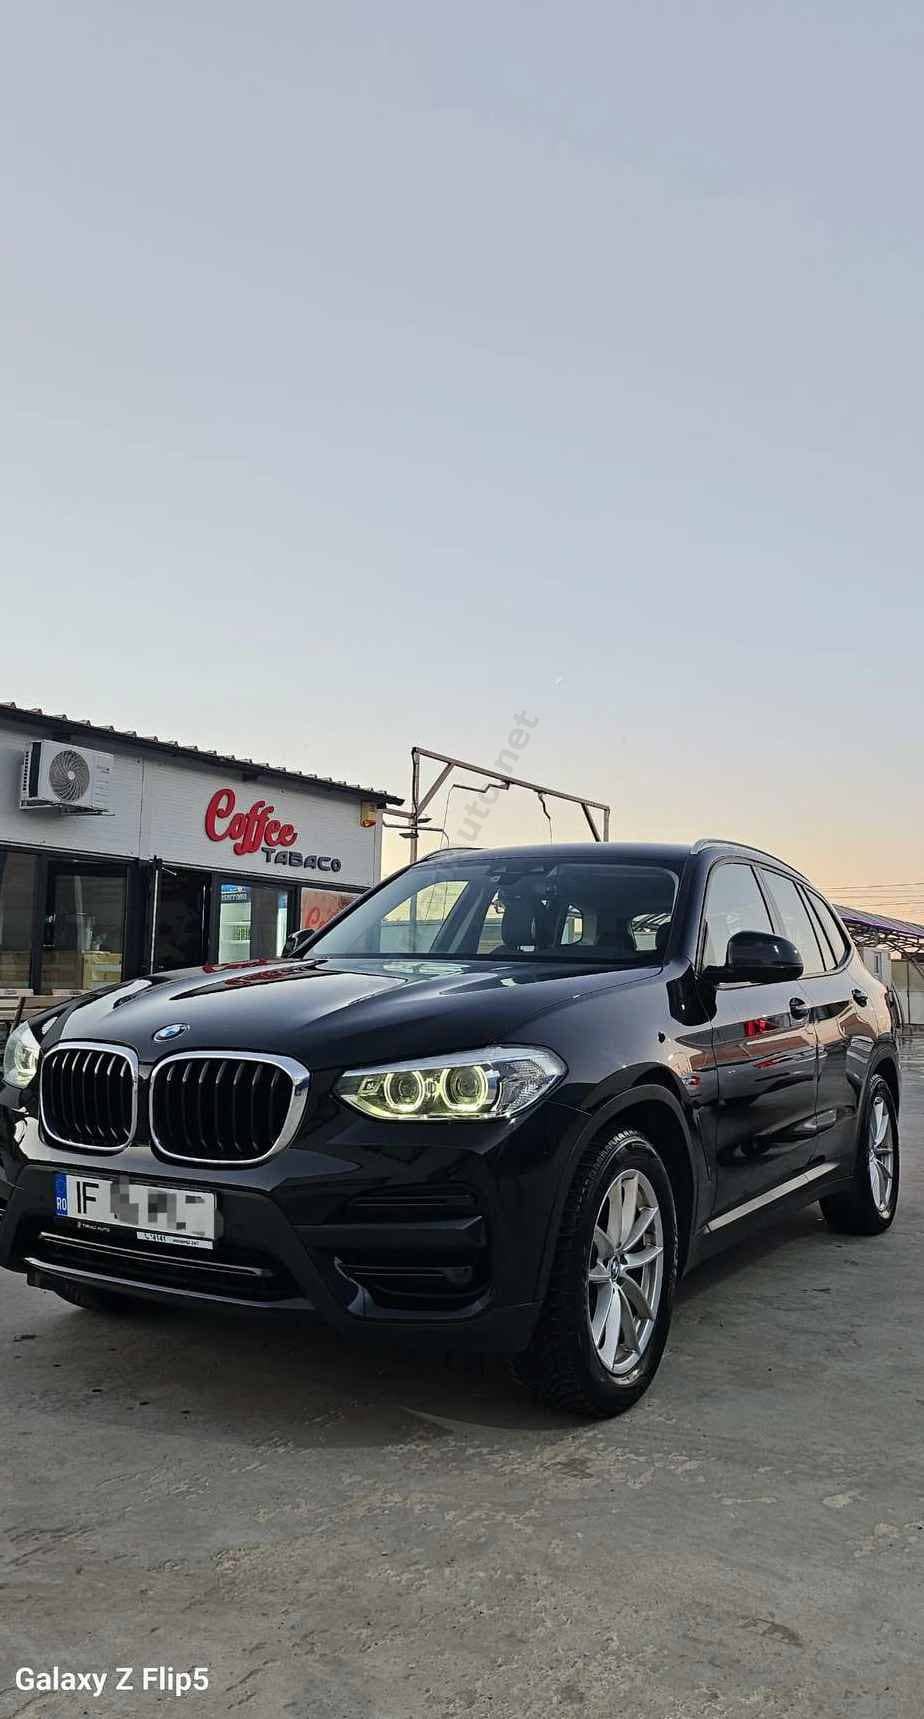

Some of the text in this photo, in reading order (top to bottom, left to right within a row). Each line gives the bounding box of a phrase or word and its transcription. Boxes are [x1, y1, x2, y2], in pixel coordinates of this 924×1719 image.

[205, 788, 298, 856] Coffee
[261, 847, 342, 872] TABACO
[56, 1197, 67, 1211] RO
[76, 1181, 99, 1214] IF
